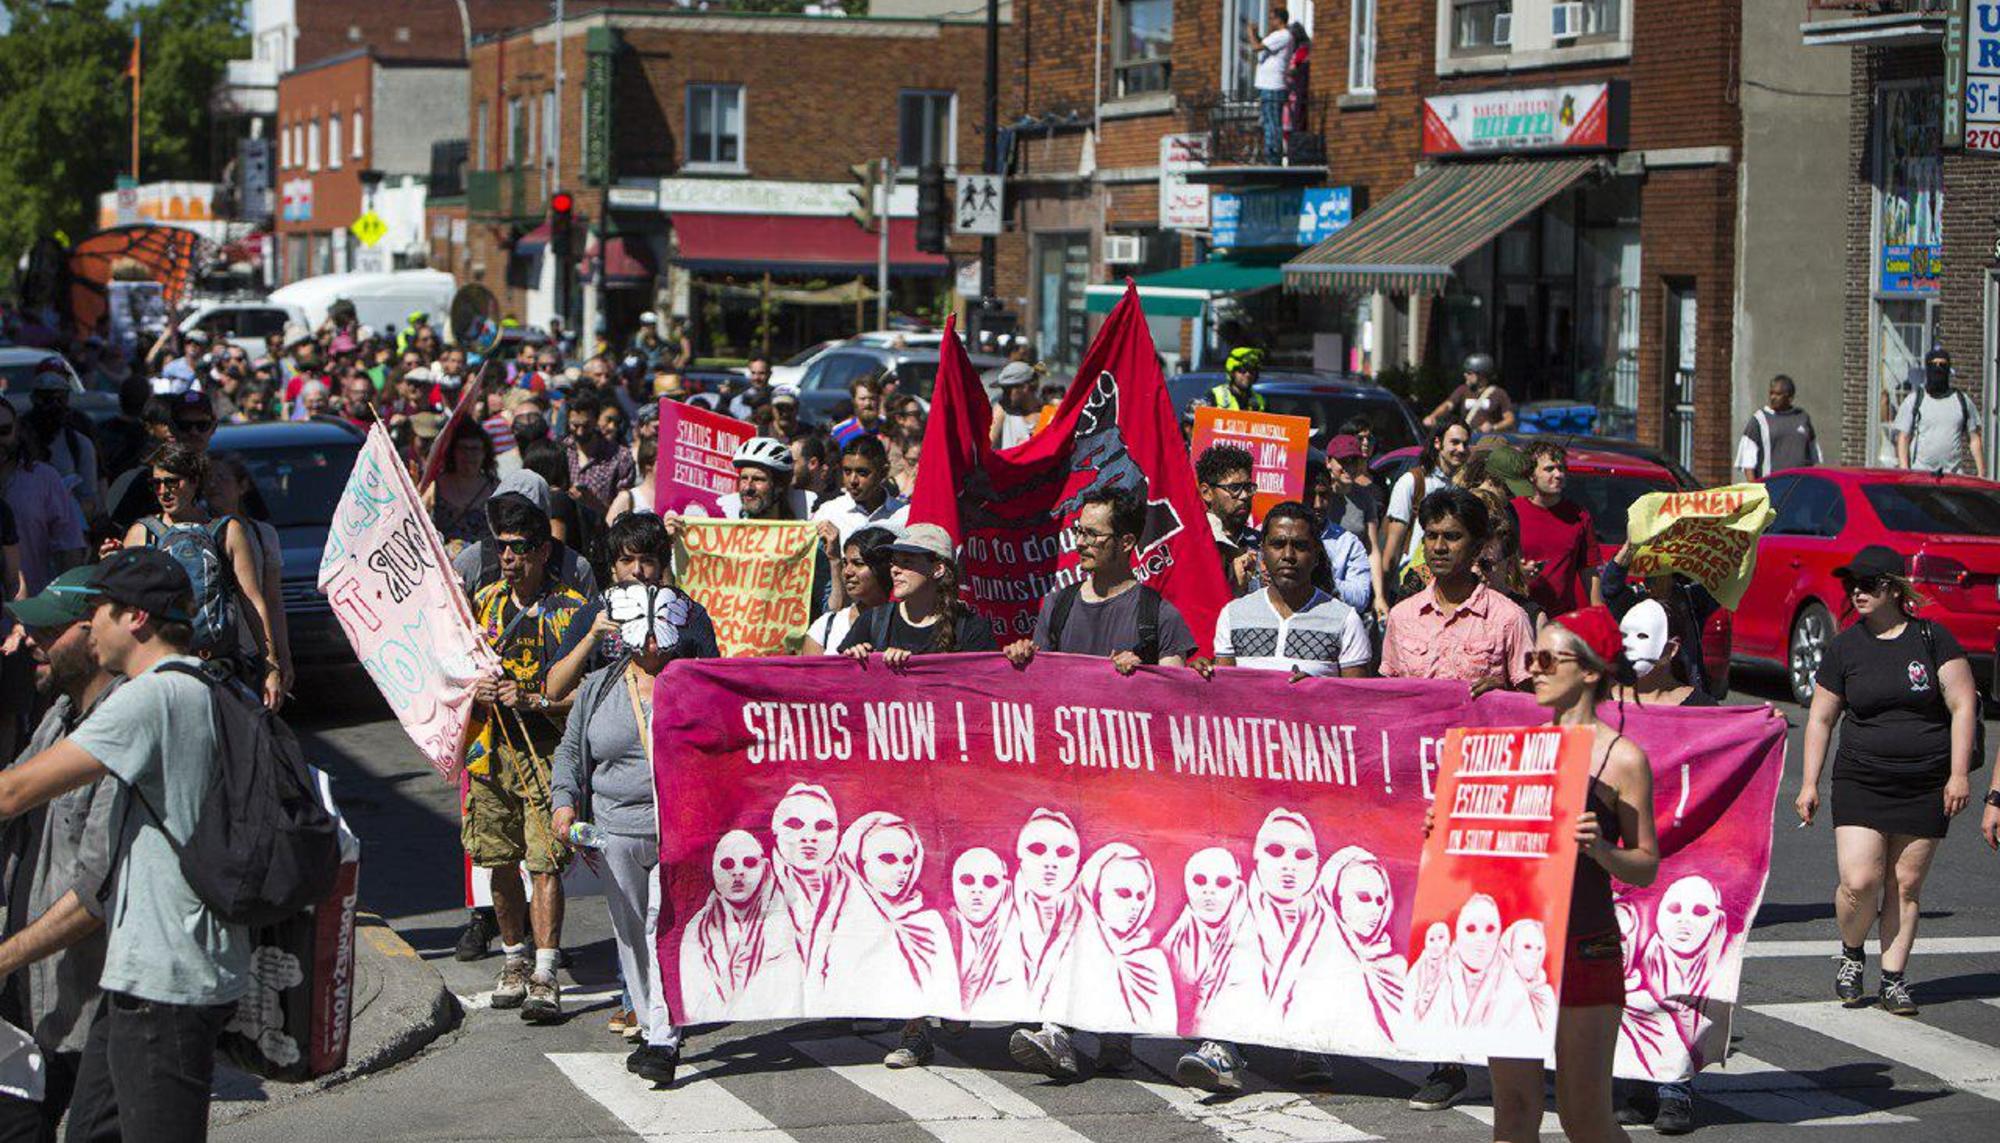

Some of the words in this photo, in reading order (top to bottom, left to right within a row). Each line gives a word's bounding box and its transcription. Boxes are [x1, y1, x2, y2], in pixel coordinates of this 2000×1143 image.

[684, 527, 767, 553] OUVREZ
[775, 528, 810, 556] LES
[742, 701, 852, 764] STATUS
[863, 701, 936, 762] NOW
[990, 701, 1036, 764] UN
[1054, 705, 1156, 772] STATUT
[1168, 714, 1358, 787] MAINTENANT
[1462, 734, 1515, 771] STATUS
[1520, 732, 1562, 771] NOW
[1453, 784, 1509, 815] ESTATUS
[1511, 785, 1554, 817] AHORA
